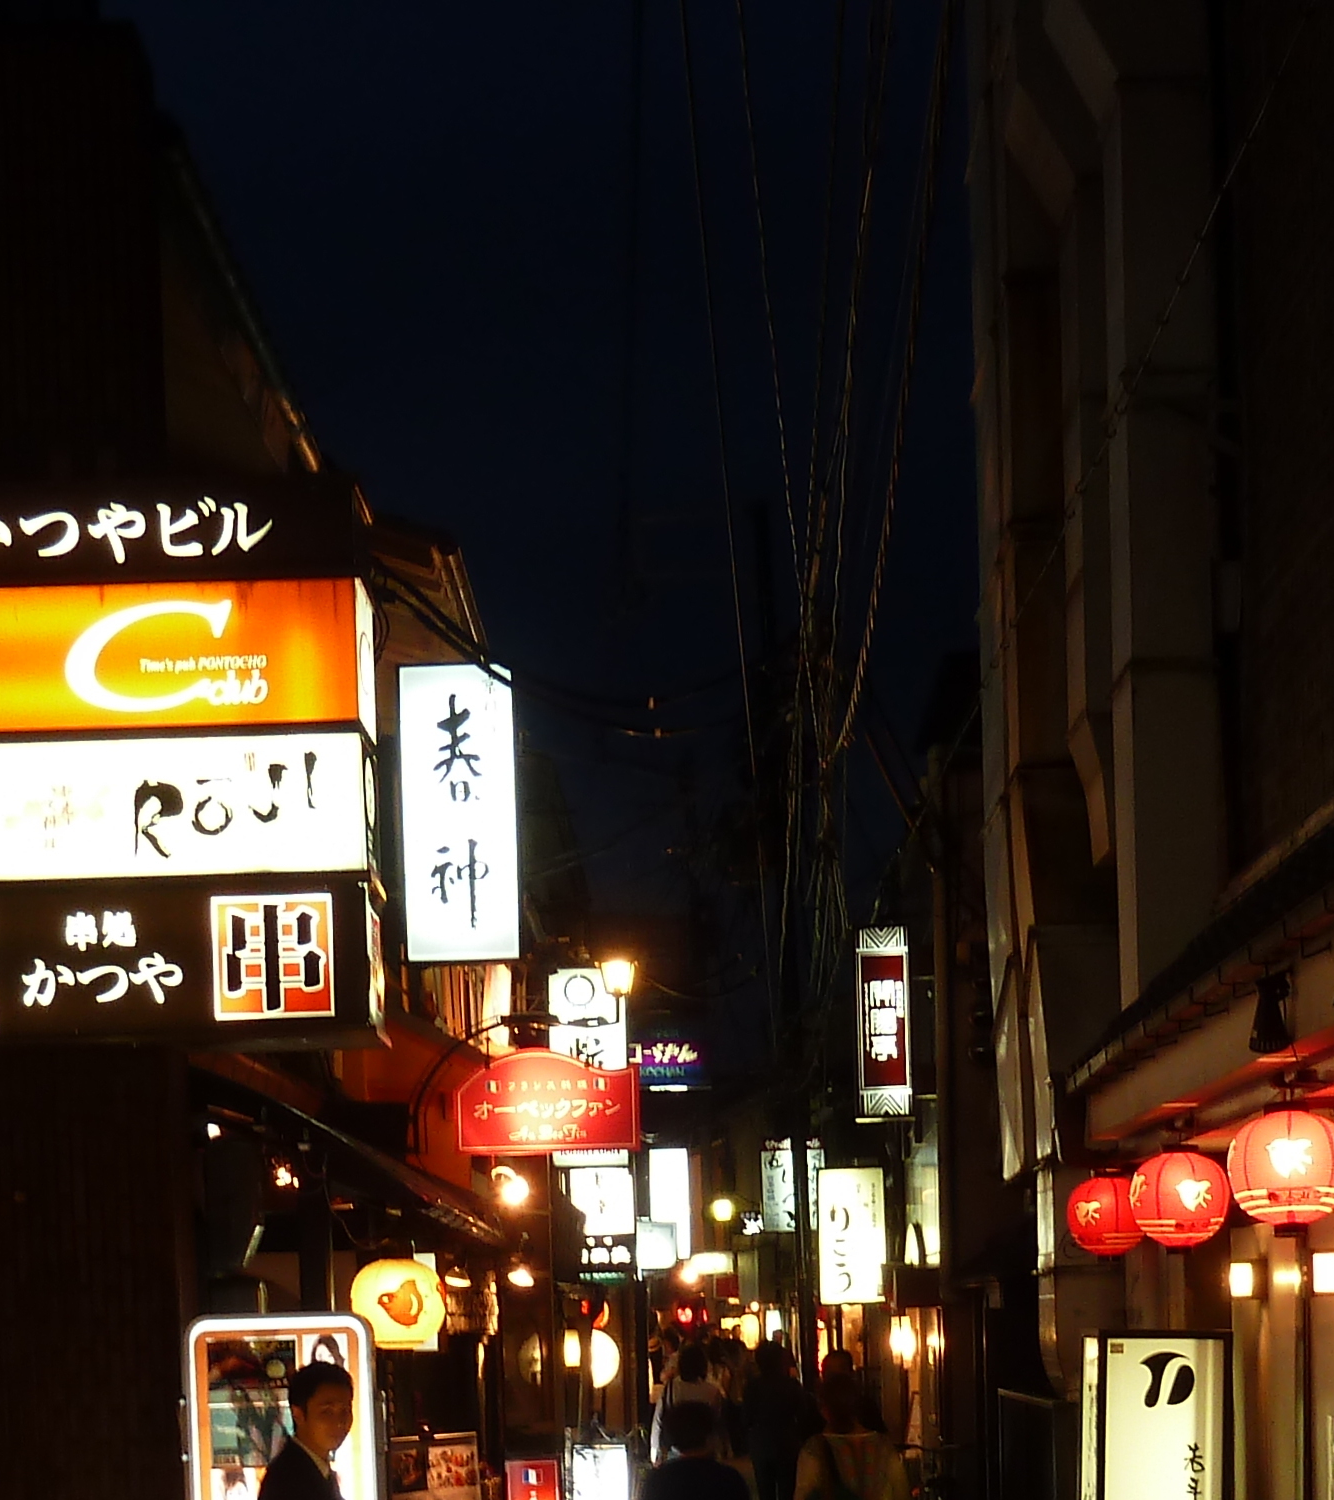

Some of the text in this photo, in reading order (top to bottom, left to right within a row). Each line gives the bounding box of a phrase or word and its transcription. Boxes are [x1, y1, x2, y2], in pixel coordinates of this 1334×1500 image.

[21, 953, 184, 1007] かつや
[473, 1098, 622, 1120] オーベックファン
